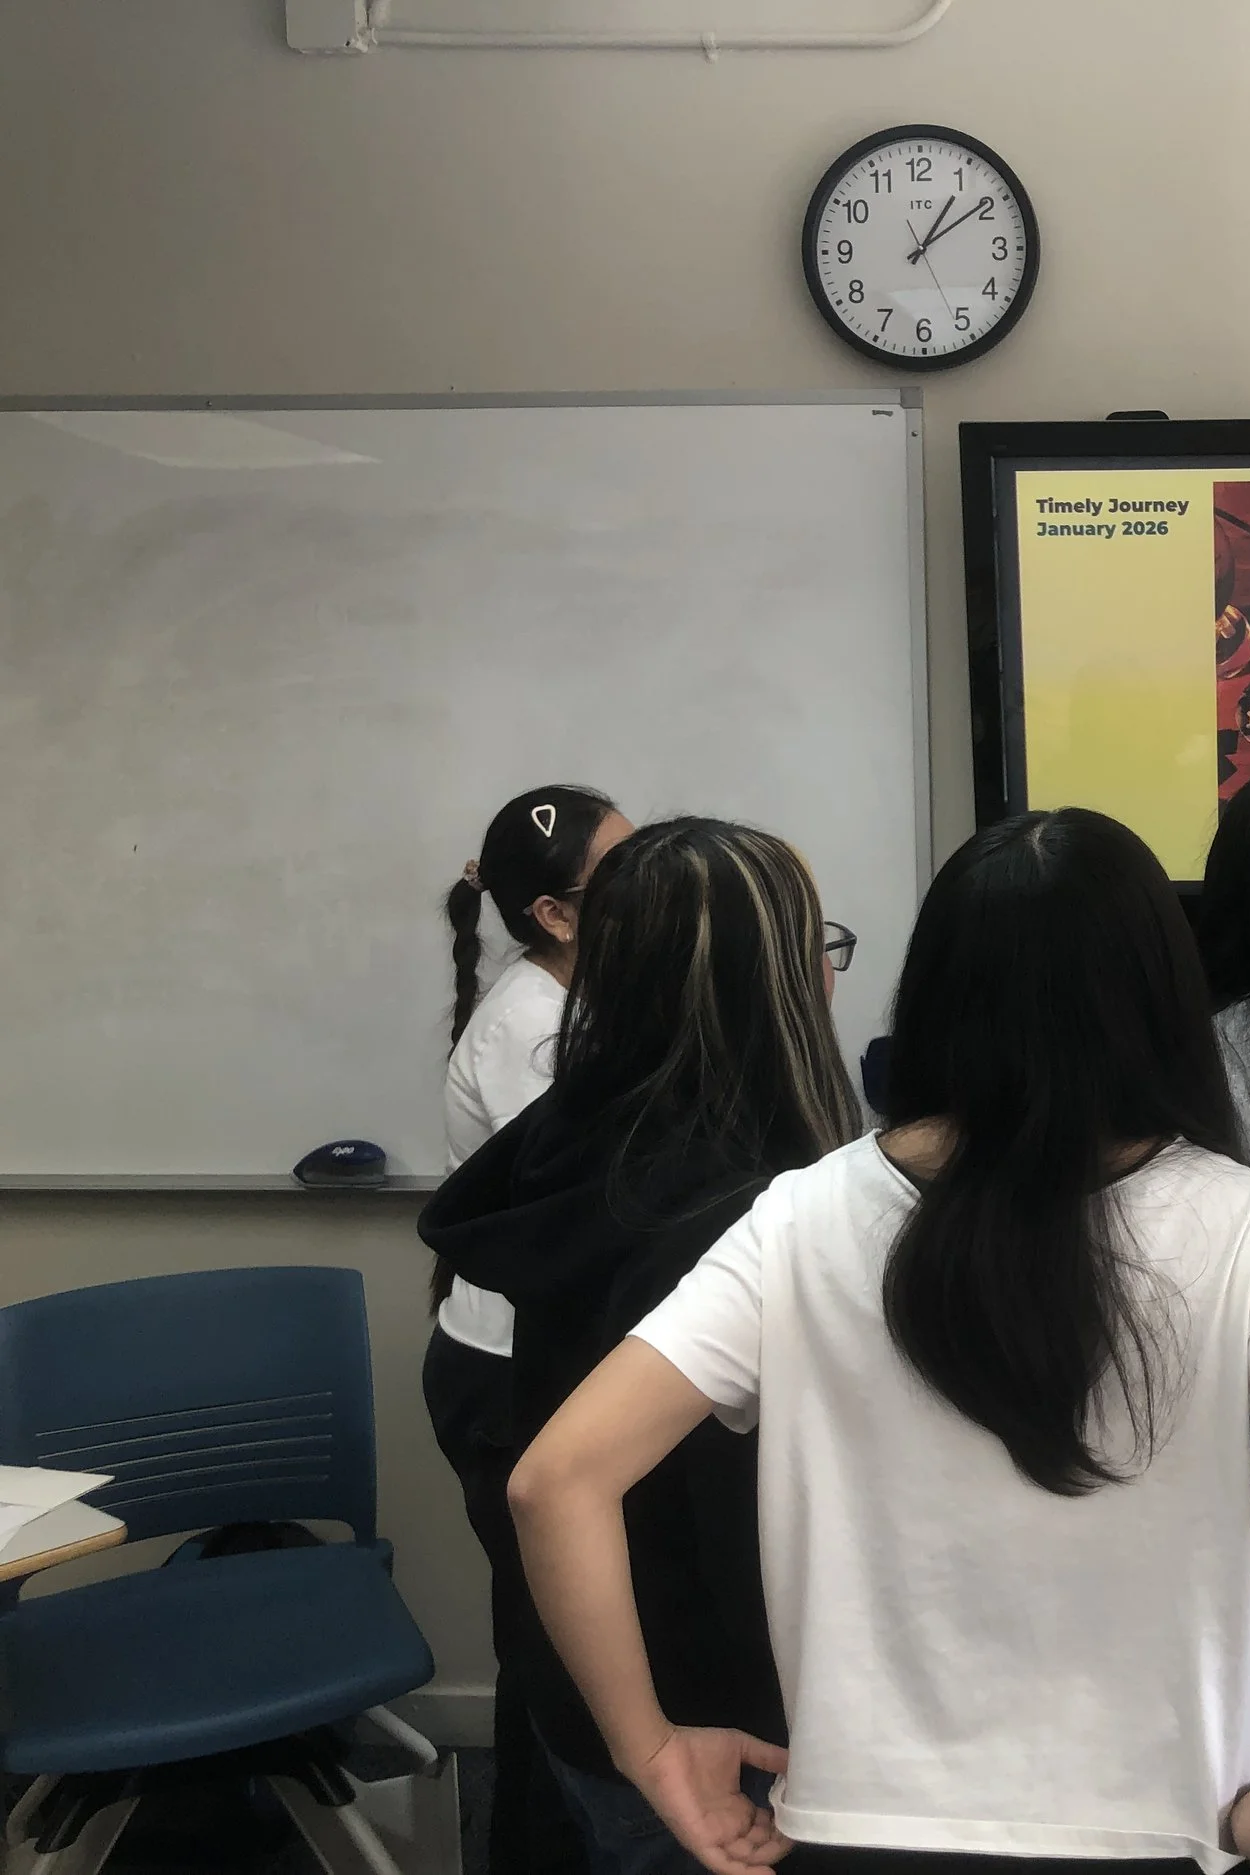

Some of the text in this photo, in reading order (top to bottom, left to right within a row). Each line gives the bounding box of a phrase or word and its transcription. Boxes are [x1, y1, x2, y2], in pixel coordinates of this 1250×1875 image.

[869, 169, 892, 194] 11
[905, 157, 932, 182] 12
[953, 167, 963, 192] 1
[842, 199, 869, 224] 10
[910, 200, 932, 210] ITC
[978, 196, 995, 221] 2
[837, 240, 853, 264] 9
[991, 236, 1008, 261] 3
[848, 279, 865, 304] 8
[981, 277, 999, 301] 4
[877, 308, 894, 332] 7
[916, 318, 932, 343] 6
[954, 307, 971, 331] 5
[1036, 497, 1190, 517] Timely Journey
[1036, 520, 1169, 540] January 2026
